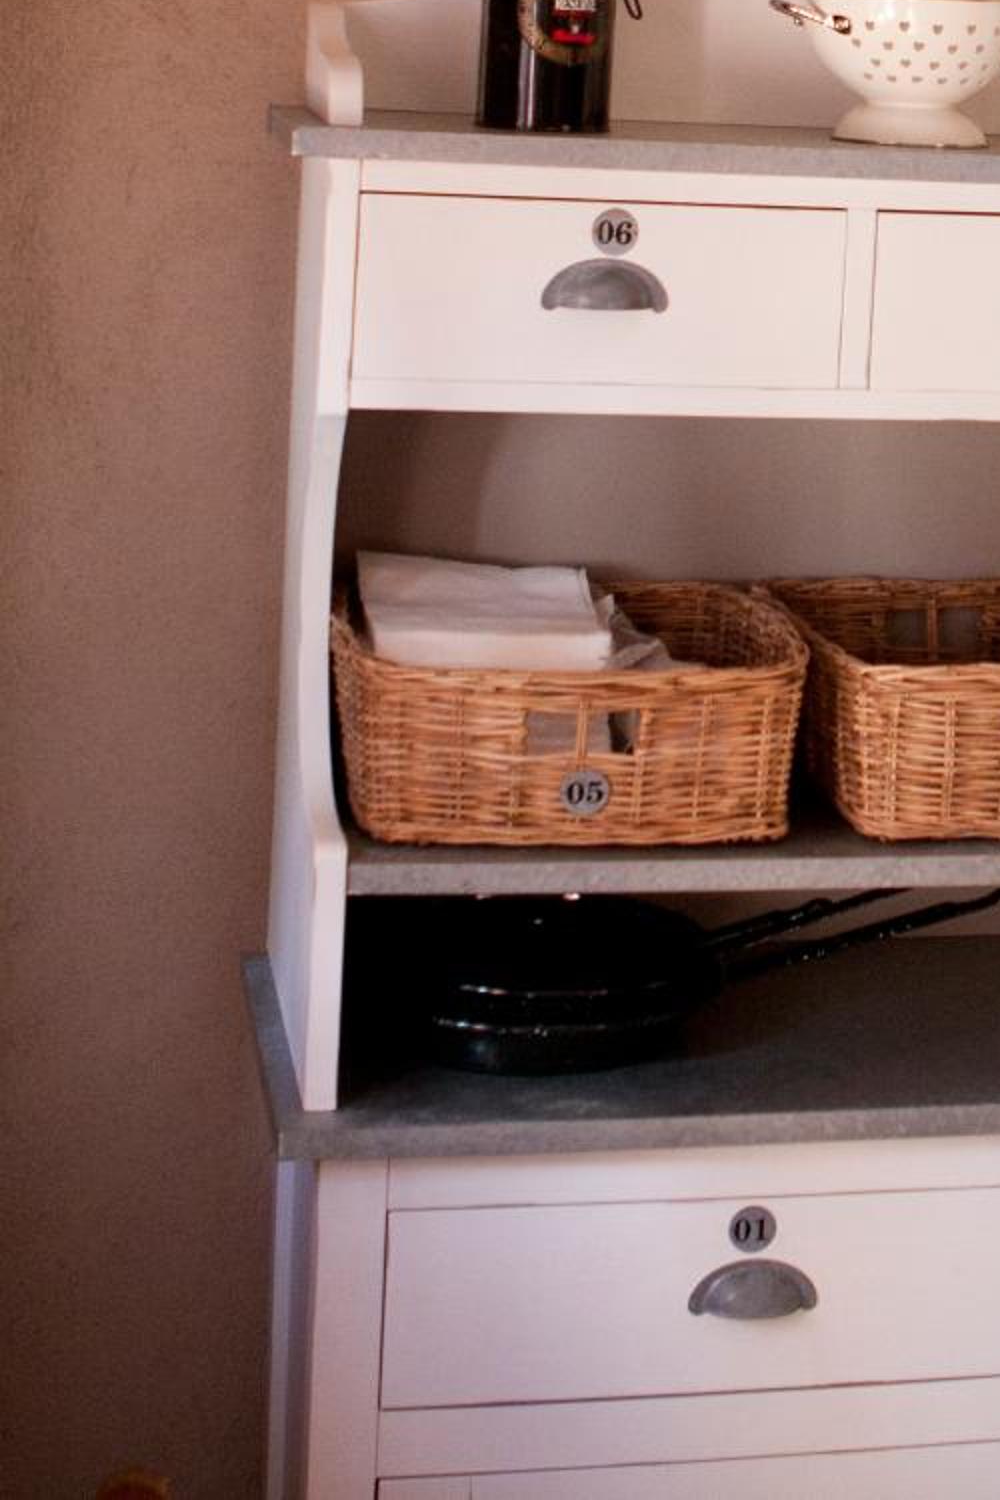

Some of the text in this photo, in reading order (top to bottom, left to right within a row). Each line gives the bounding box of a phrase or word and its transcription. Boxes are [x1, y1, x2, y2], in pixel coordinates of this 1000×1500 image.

[597, 219, 633, 246] 06
[567, 781, 604, 805] 05
[734, 1218, 766, 1242] 01
